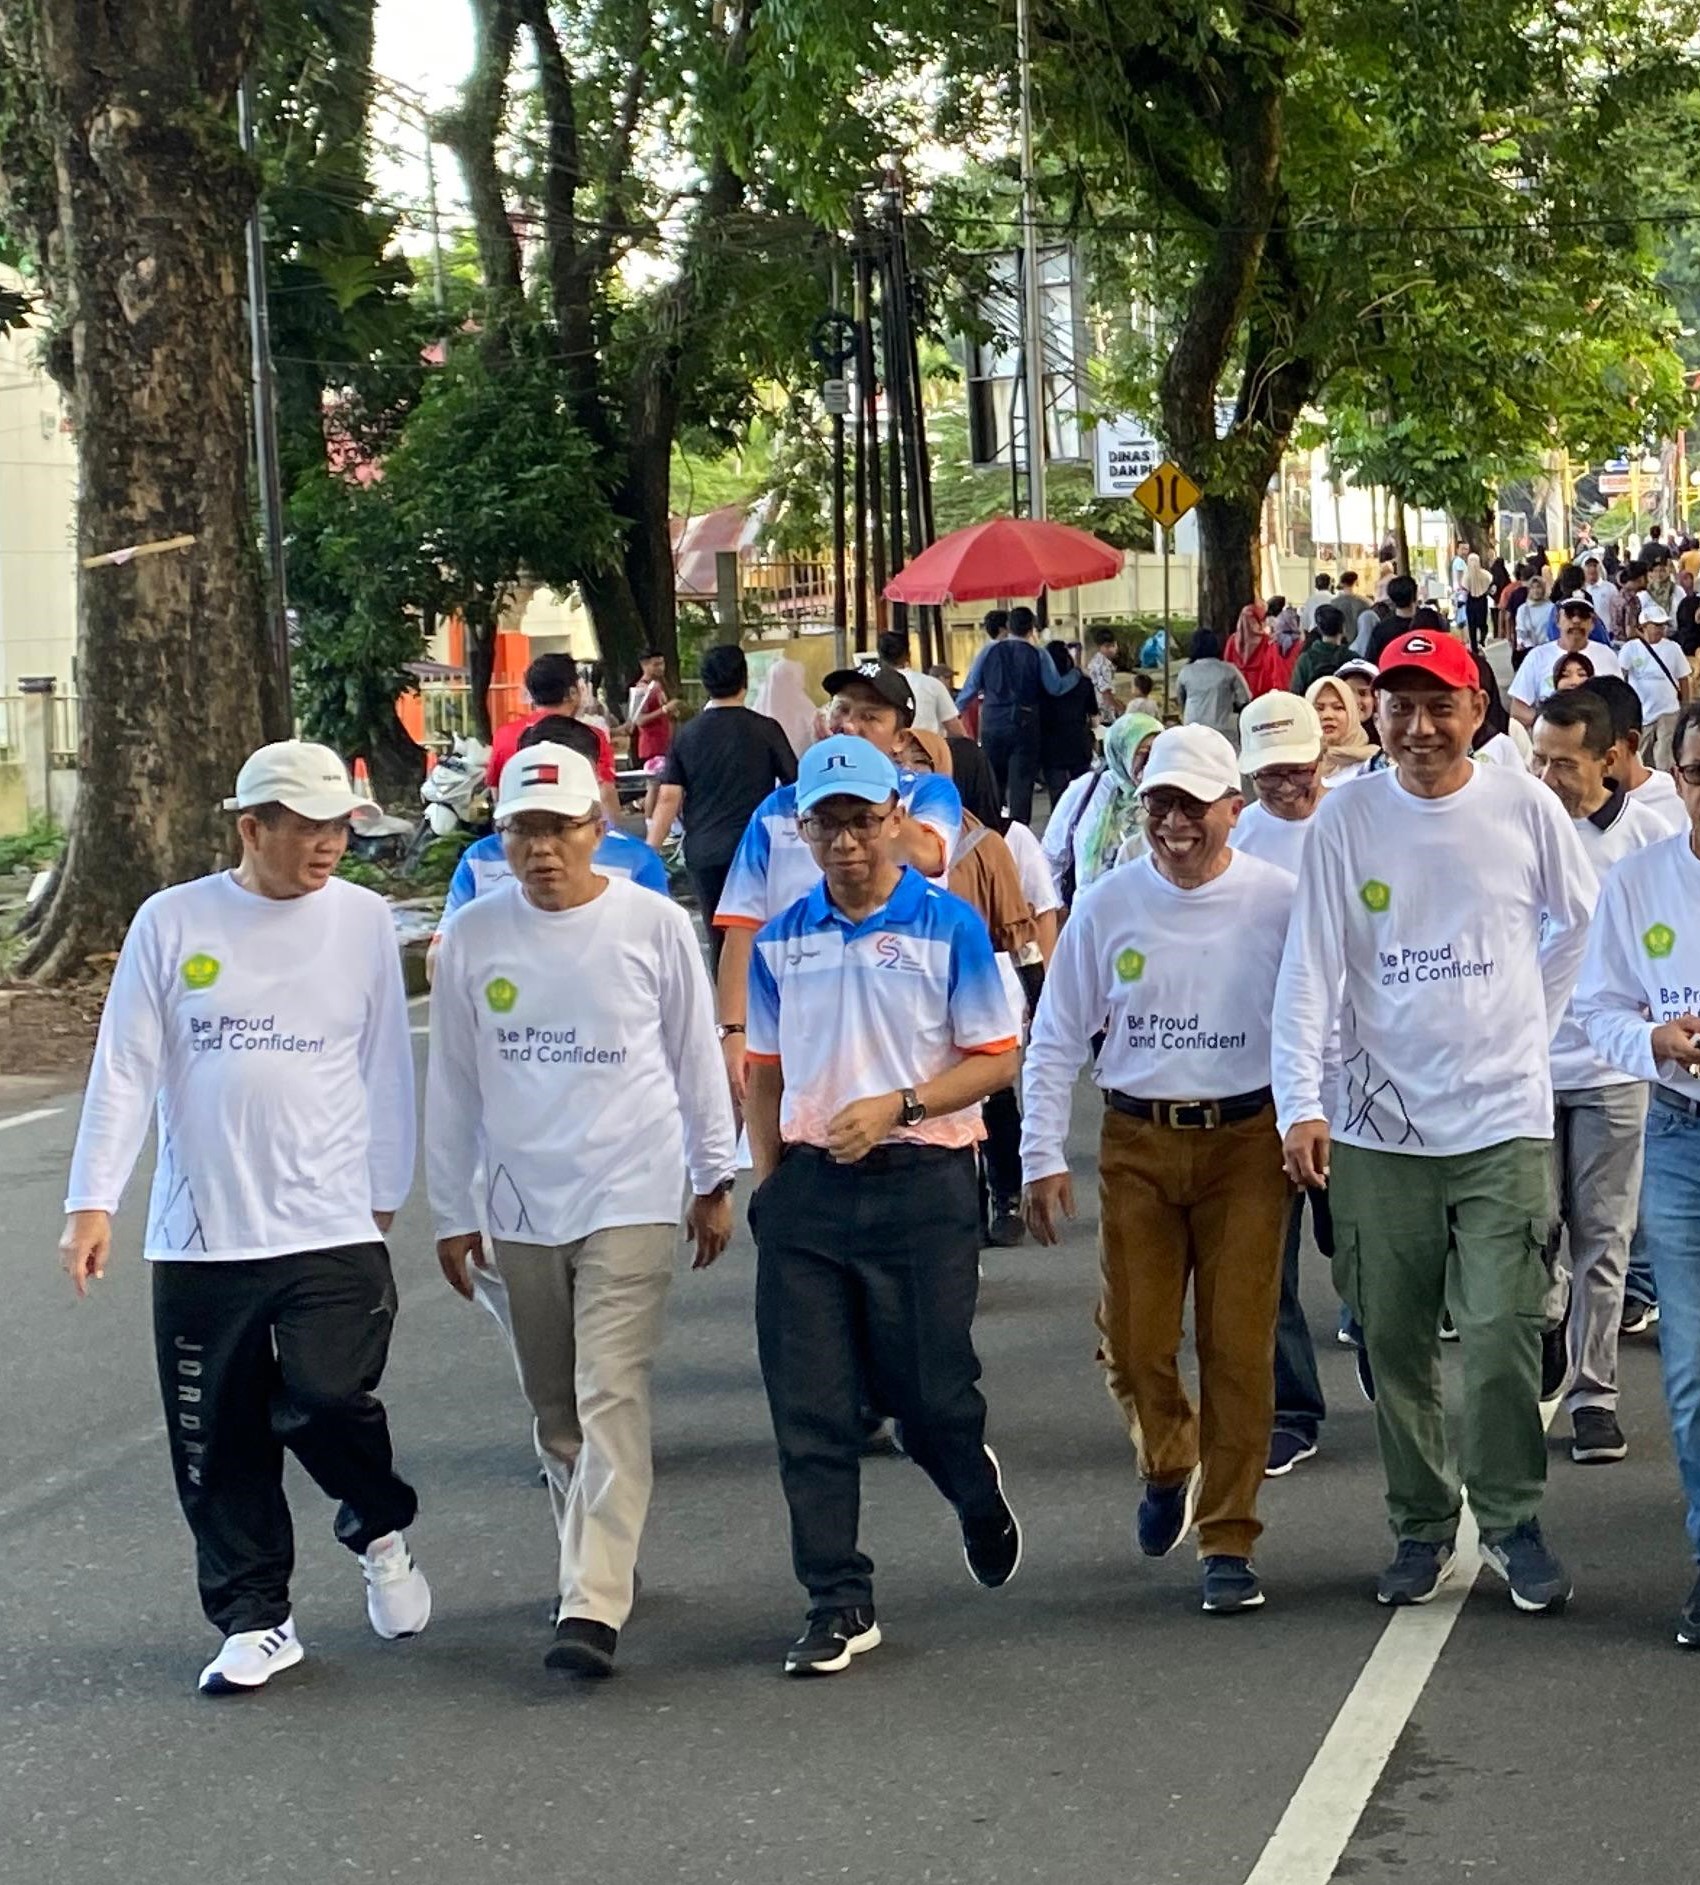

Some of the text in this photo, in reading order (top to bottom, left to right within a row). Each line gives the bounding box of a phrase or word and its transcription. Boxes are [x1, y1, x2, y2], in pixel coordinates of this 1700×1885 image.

[1109, 450, 1150, 463] DINAS
[1110, 465, 1138, 477] DAN
[1402, 944, 1451, 965] Proud
[1415, 960, 1494, 982] Confident
[1660, 988, 1680, 1004] Be
[190, 1015, 275, 1033] Be Proud
[1127, 1014, 1199, 1030] Be Proud
[193, 1033, 325, 1053] and Confident
[497, 1027, 576, 1044] Be Proud
[1129, 1032, 1246, 1049] and Confident
[500, 1046, 627, 1063] and Confident
[174, 1335, 206, 1486] JORDAN
